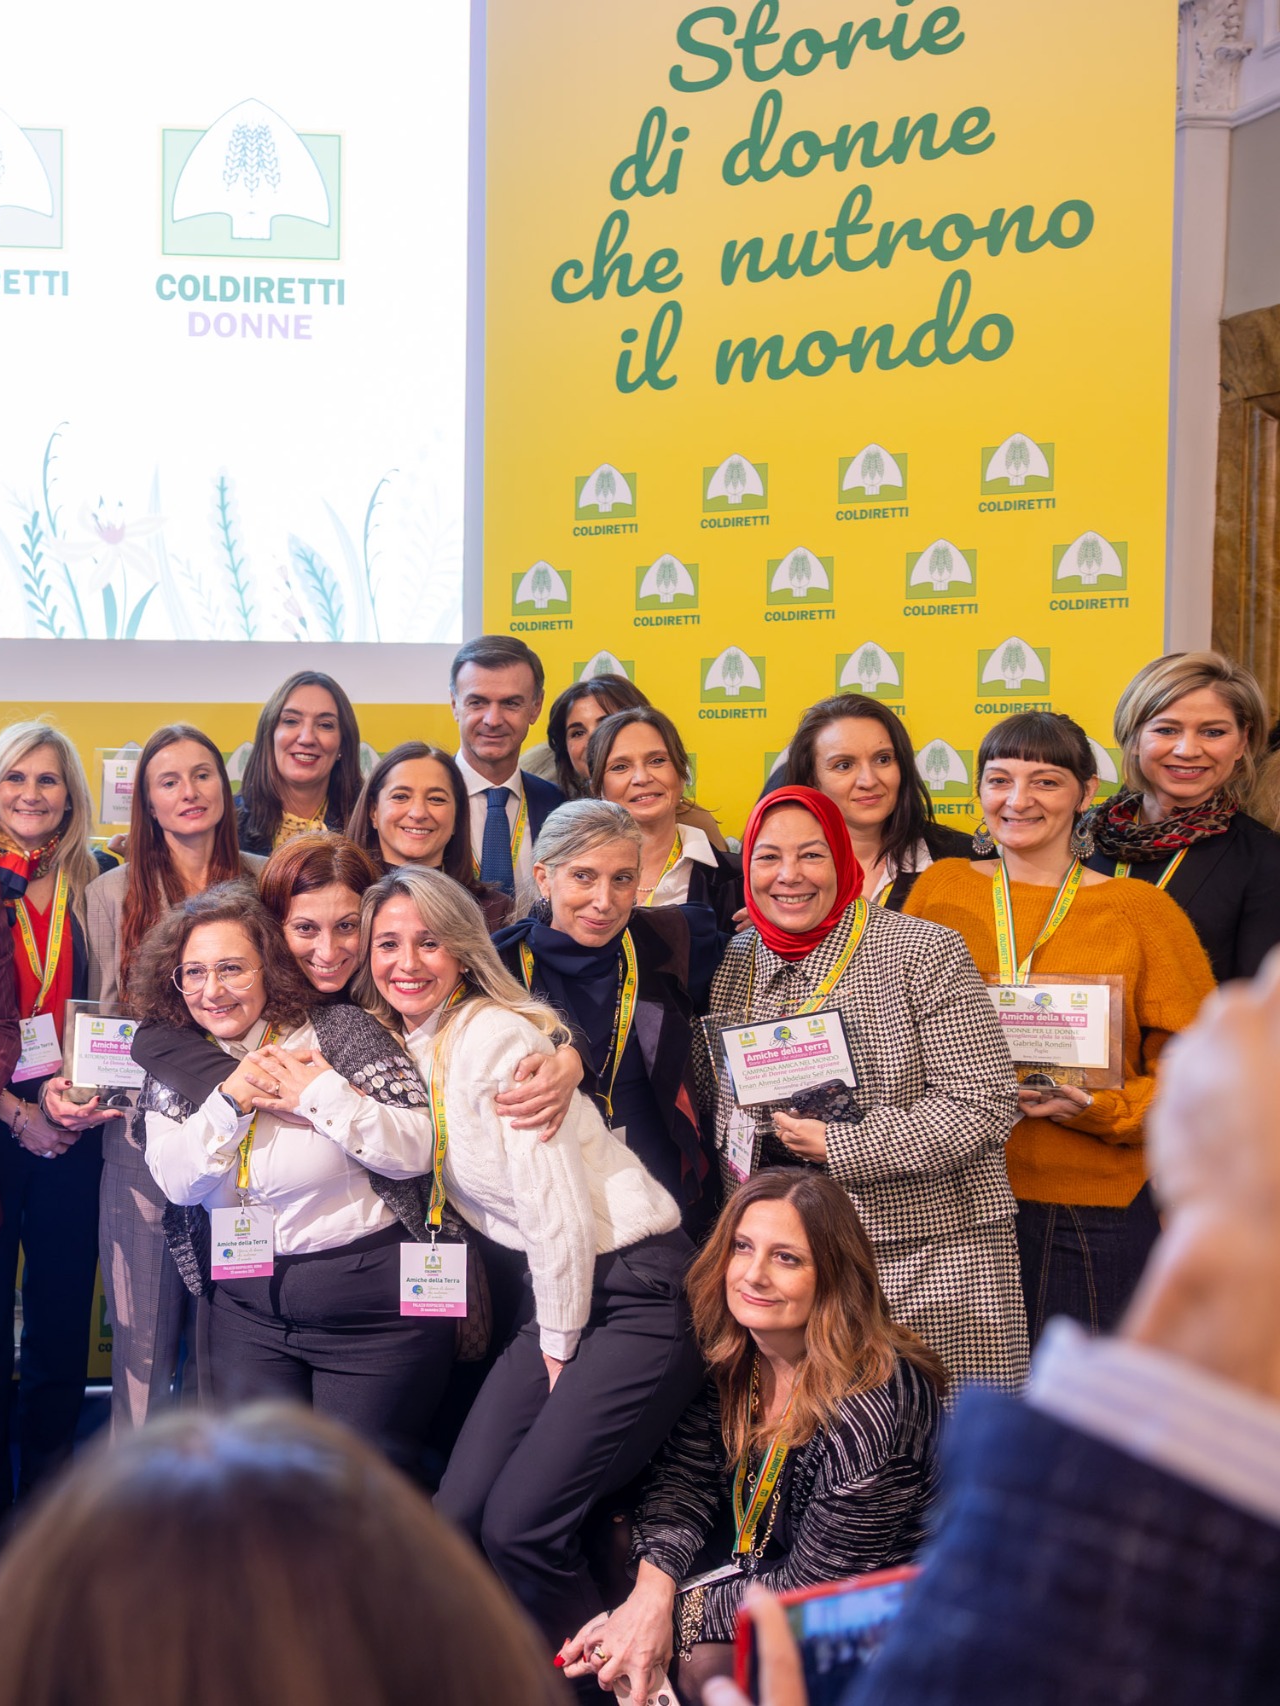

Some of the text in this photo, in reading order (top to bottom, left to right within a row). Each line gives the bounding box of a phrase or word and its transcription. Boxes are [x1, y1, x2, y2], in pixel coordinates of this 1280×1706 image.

[669, 0, 965, 93] Storie
[610, 89, 995, 201] di donne
[550, 184, 1094, 304] che nutrono
[156, 273, 345, 305] COLDIRETTI
[187, 311, 313, 340] DONNE
[616, 269, 1014, 394] il mondo
[978, 498, 1056, 512] COLDIRETTI
[836, 507, 909, 521] COLDIRETTI
[700, 515, 769, 529] COLDIRETTI
[573, 523, 638, 537] COLDIRETTI
[903, 603, 978, 617] COLDIRETTI
[1049, 597, 1129, 611] COLDIRETTI
[633, 614, 700, 627] COLDIRETTI
[764, 609, 835, 622] COLDIRETTI
[510, 620, 573, 632] COLDIRETTI
[698, 708, 767, 720] COLDIRETTI
[621, 993, 631, 1030] COLDIRETTI
[1037, 1013, 1059, 1021] della
[1061, 1014, 1085, 1022] terra
[92, 1041, 119, 1050] Amiche
[747, 1042, 828, 1062] Amiche della terra
[766, 1446, 785, 1483] COLDIRETTI
[746, 1501, 764, 1534] COLDIRETTI
